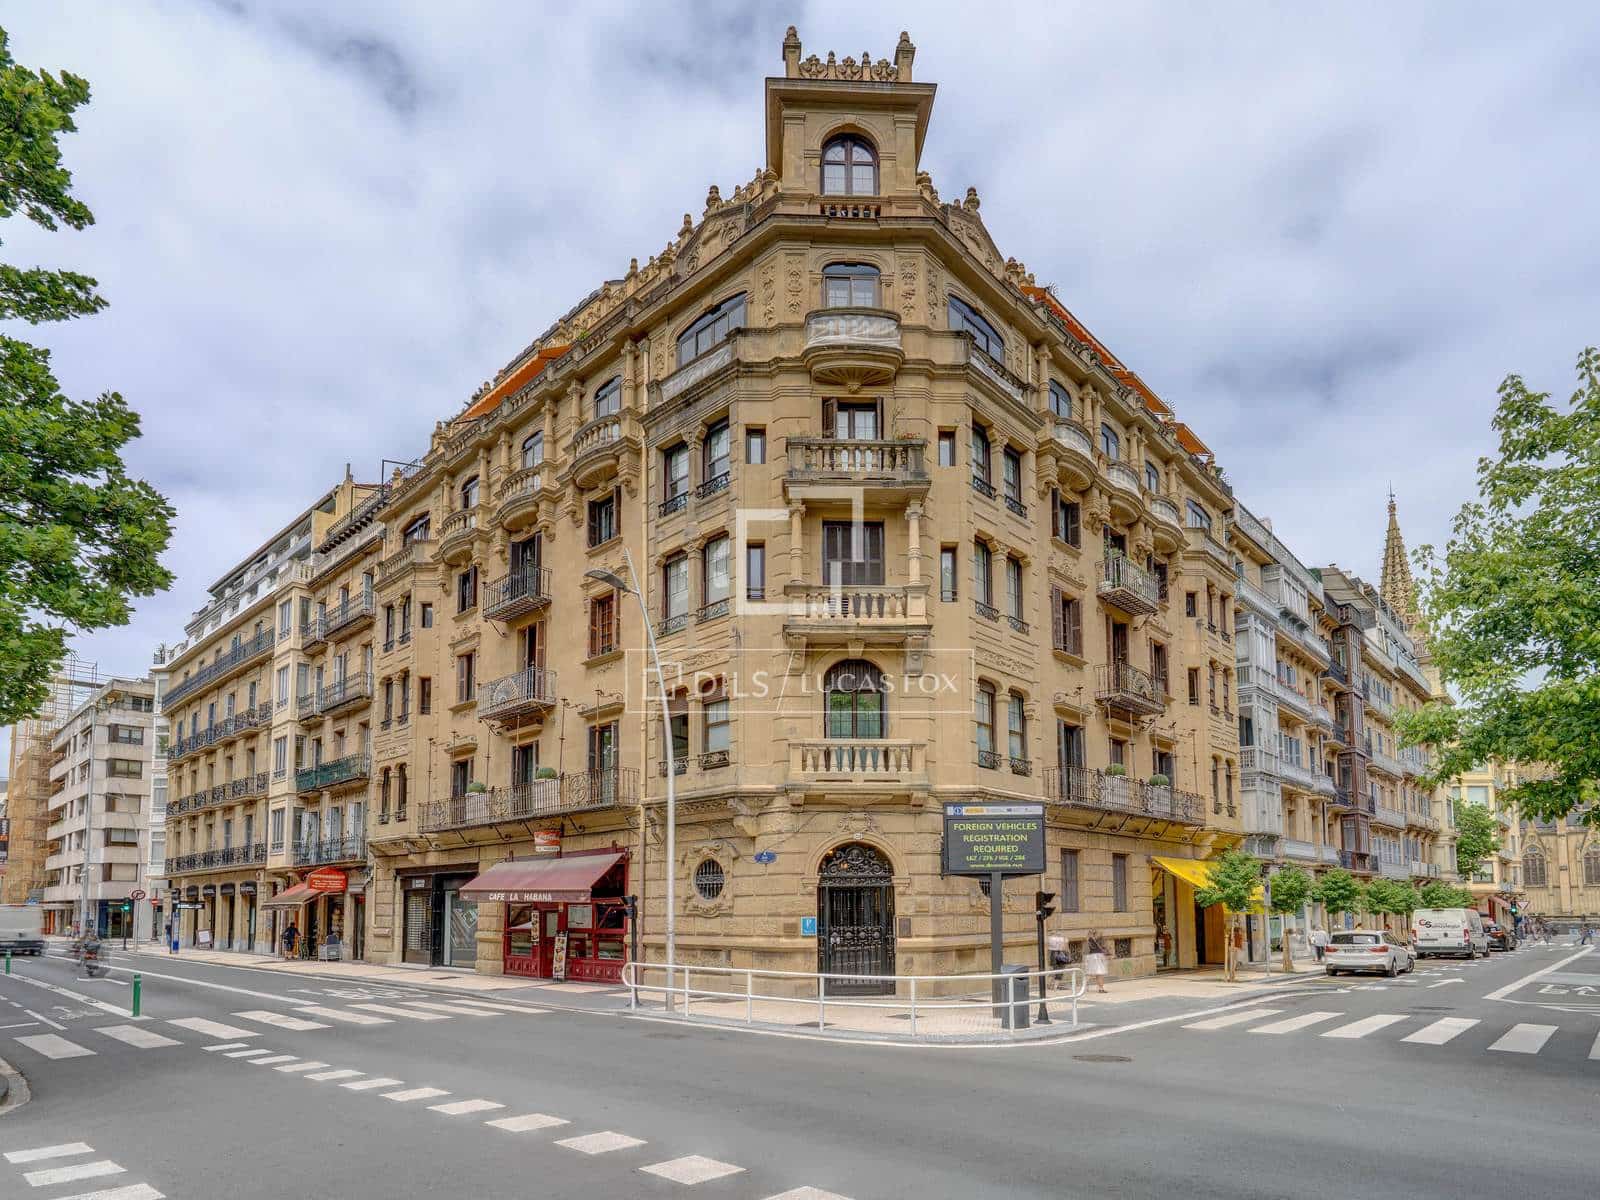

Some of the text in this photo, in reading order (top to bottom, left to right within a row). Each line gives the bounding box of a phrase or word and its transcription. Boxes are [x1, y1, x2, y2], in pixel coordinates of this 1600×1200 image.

[953, 822, 1038, 831] FOREIGN VEHICLES
[963, 834, 1028, 842] REGISTRATION
[973, 845, 1019, 853] REQUIRED
[509, 892, 519, 901] LA
[523, 892, 552, 902] HABANA
